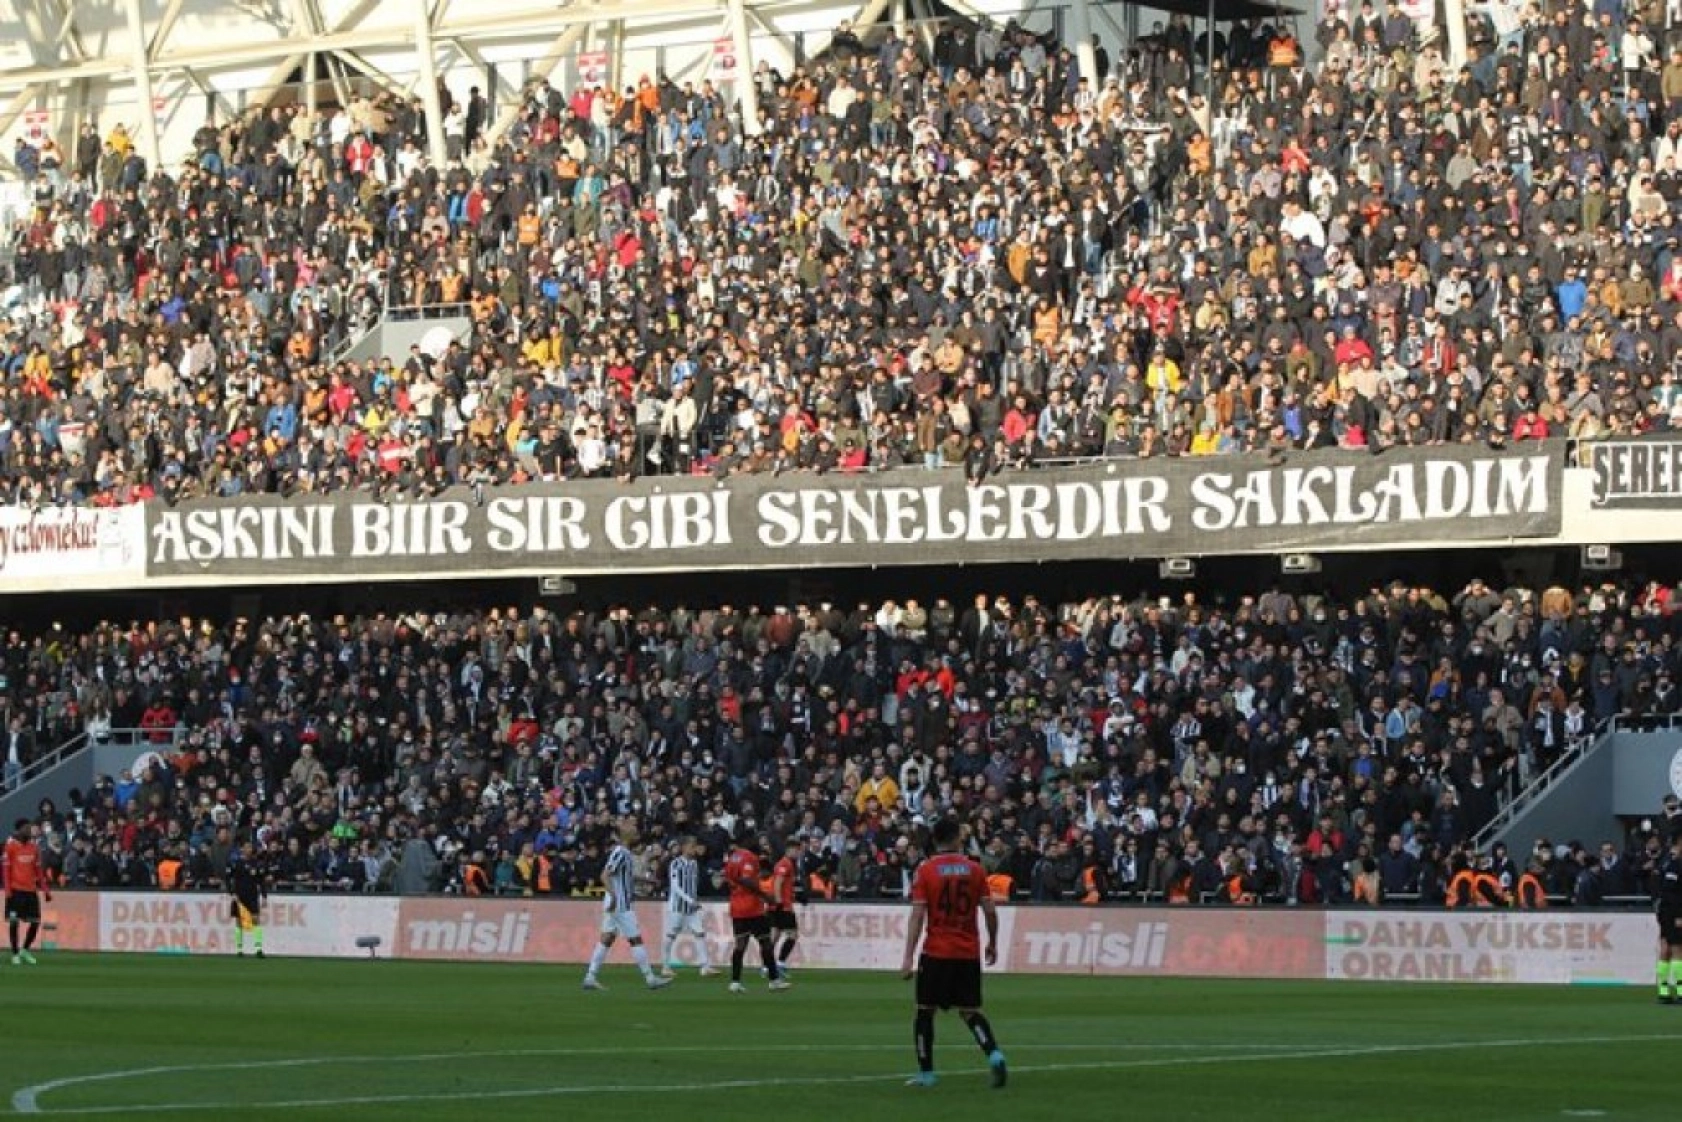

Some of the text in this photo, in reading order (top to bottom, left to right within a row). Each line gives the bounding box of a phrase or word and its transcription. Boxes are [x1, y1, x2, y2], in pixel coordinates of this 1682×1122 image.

[153, 505, 335, 568] AŞKINI
[487, 497, 591, 551] SIR
[604, 480, 732, 550] GİBİ
[758, 463, 1171, 547] SENELERDİR
[1190, 456, 1548, 530] SAKLADIM
[1343, 915, 1613, 950] DAHA YÜKSEK
